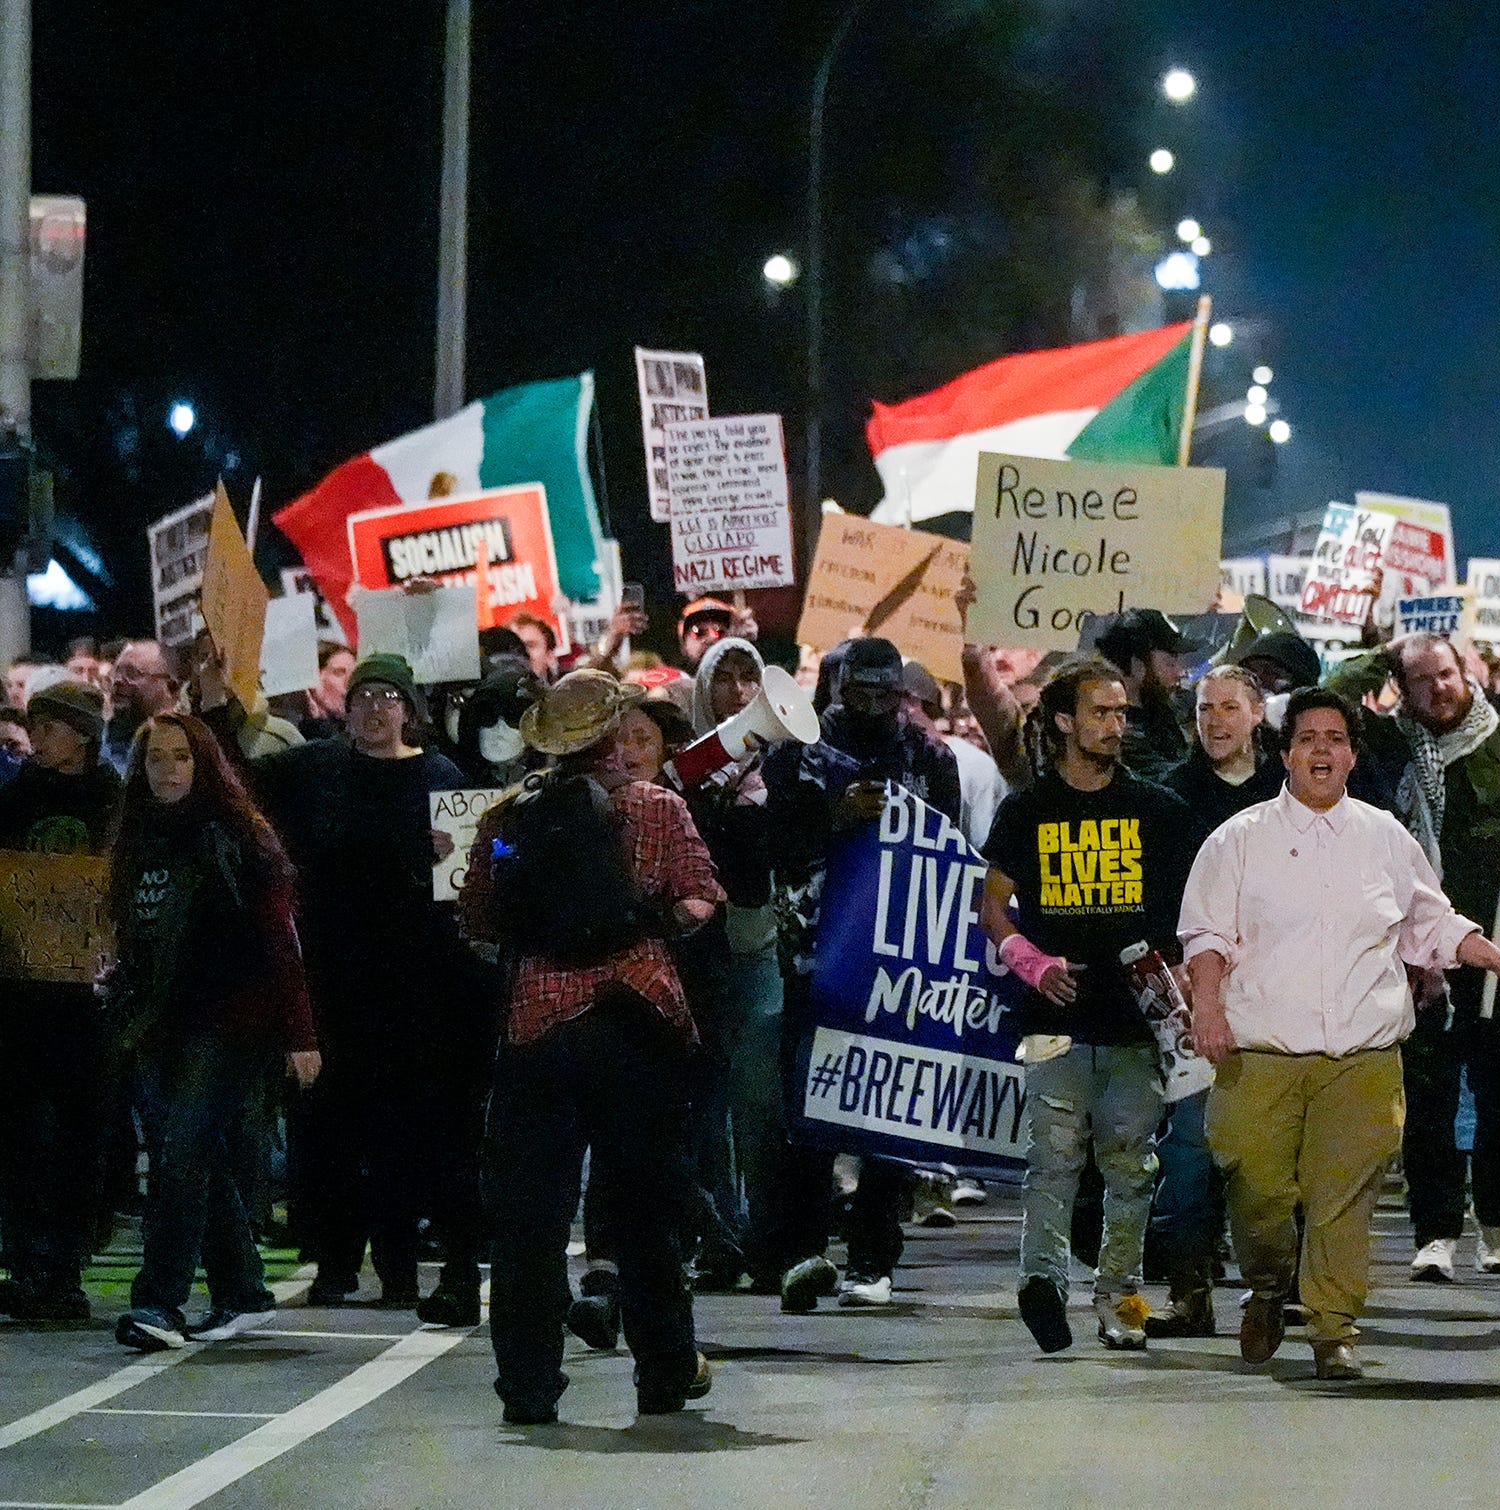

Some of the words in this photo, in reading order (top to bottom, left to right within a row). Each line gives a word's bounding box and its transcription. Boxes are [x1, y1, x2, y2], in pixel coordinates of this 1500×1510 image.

[995, 464, 1139, 521] Renee
[675, 560, 715, 584] NAZI
[722, 554, 784, 580] REGIME
[1013, 531, 1131, 576] Nicole
[879, 780, 970, 856] BLA
[1038, 819, 1142, 854] BLACK
[1039, 849, 1143, 884] LIVES
[1040, 881, 1143, 907] MATTER
[865, 966, 1010, 1037] Matter
[810, 1043, 1028, 1145] #BREEWAYY
